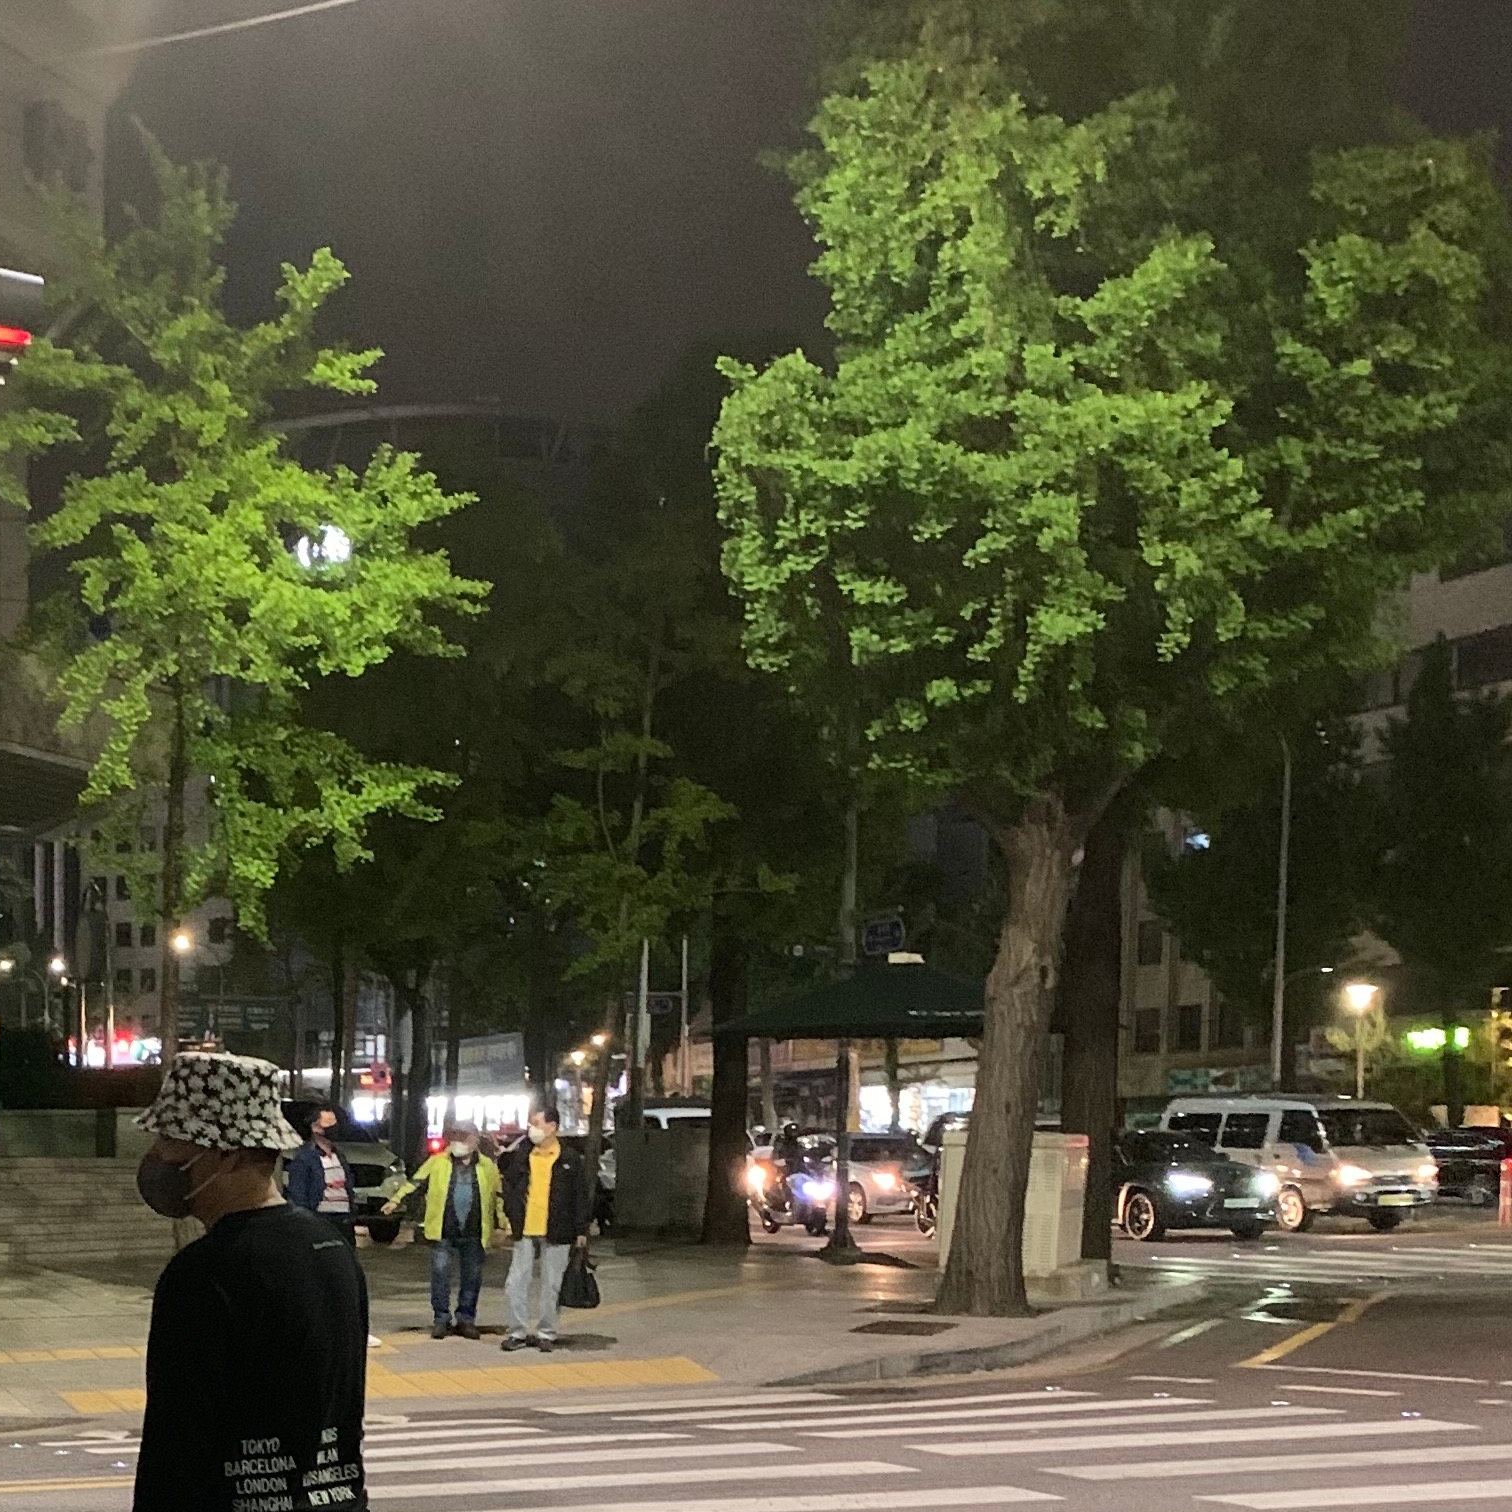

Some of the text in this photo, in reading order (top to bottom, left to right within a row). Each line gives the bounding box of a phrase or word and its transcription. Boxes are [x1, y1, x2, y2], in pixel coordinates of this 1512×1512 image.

[241, 1437, 281, 1455] TOKYO
[224, 1455, 297, 1477] BARCELONA
[236, 1477, 288, 1495] LONDON
